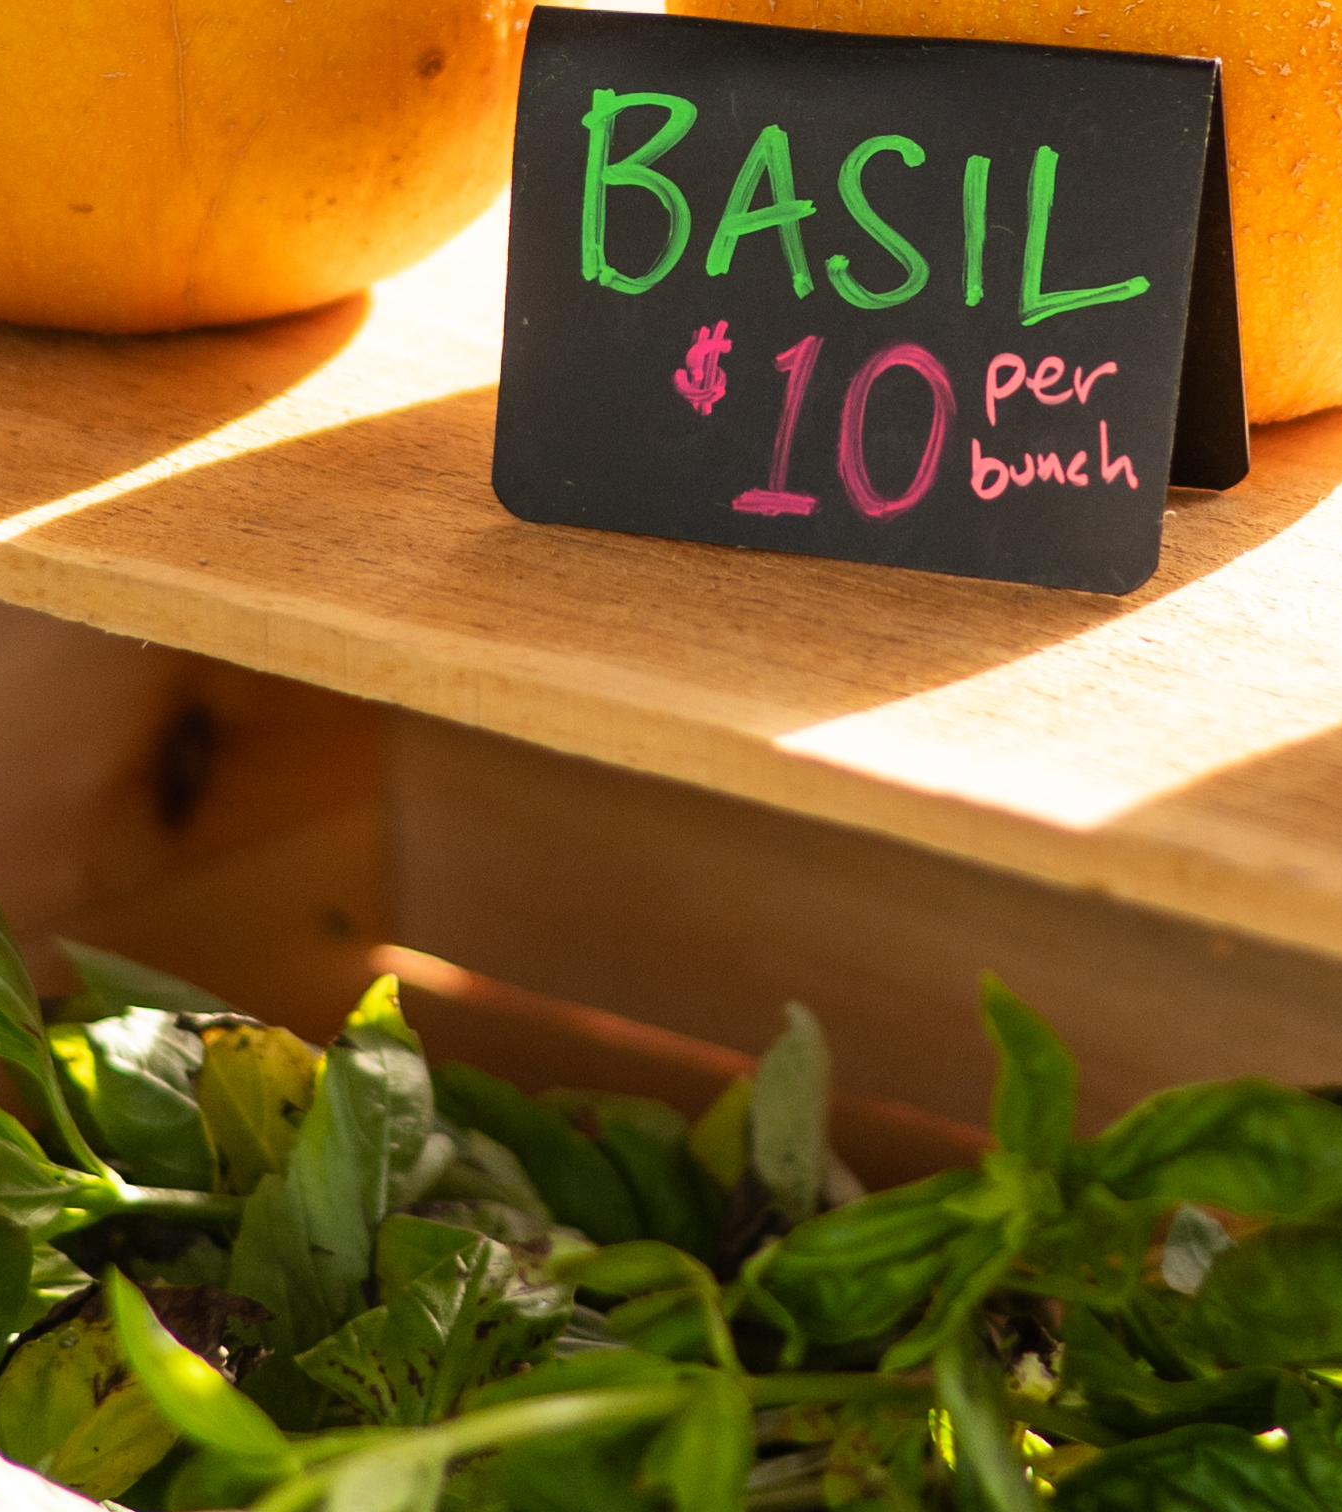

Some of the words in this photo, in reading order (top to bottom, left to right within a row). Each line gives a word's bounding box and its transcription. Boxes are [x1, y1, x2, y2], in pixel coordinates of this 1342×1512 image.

[581, 88, 1152, 327] BASIL
[673, 319, 956, 521] $10
[985, 351, 1119, 427] per
[970, 419, 1140, 501] bunch
